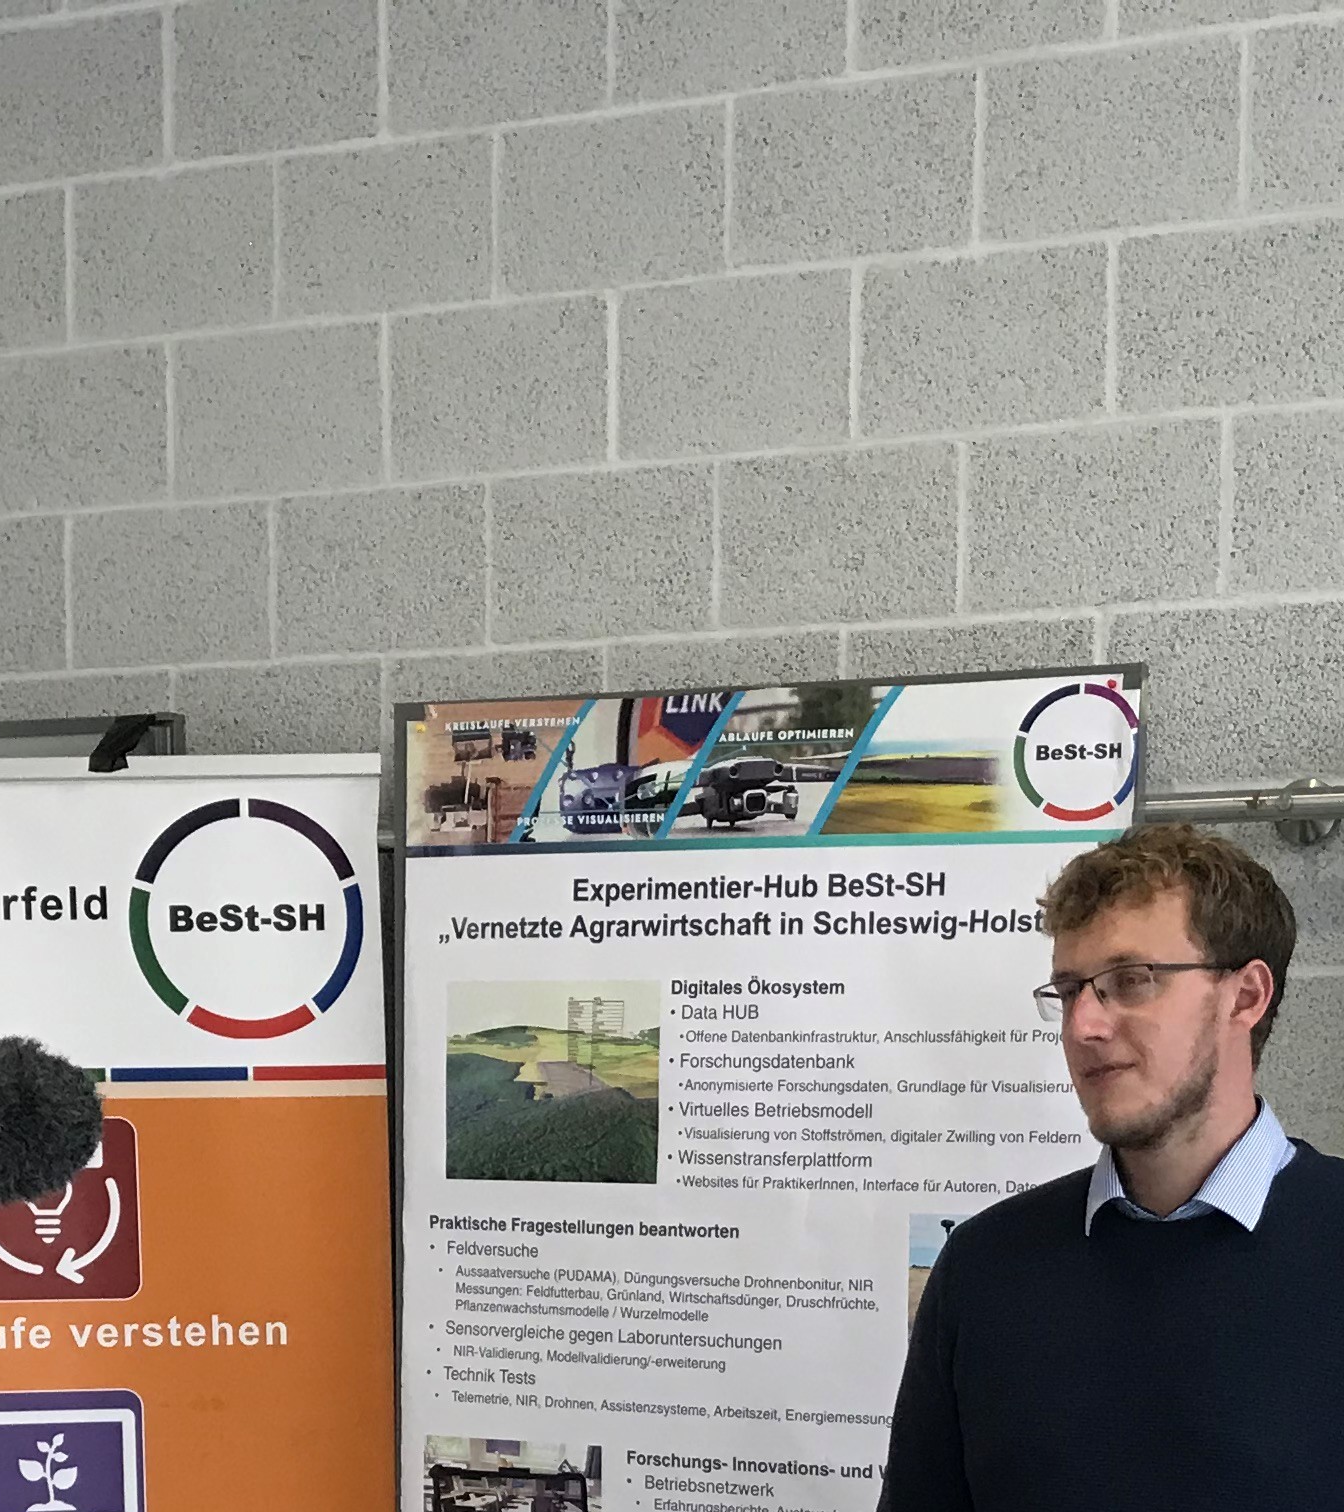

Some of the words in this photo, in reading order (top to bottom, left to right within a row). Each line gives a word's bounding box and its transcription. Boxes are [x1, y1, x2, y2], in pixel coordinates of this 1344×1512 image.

[1035, 742, 1123, 761] BeSt-SH
[573, 873, 819, 908] Experimentier-Hub
[827, 871, 946, 898] BeSt-SH
[168, 903, 326, 933] BeSt-SH
[569, 911, 772, 944] Agrarwirtschaft
[780, 911, 804, 936] in
[813, 908, 1043, 941] Schleswig-Holst
[671, 979, 743, 999] Digitales
[747, 975, 845, 999] Ökosystem
[681, 1004, 718, 1021] Data
[722, 1003, 760, 1020] HUB
[685, 1029, 728, 1043] Offene
[731, 1029, 880, 1045] Datenbankinfrastruktur,
[883, 1029, 1007, 1047] Anschlussfähigkeit
[679, 1052, 855, 1073] Forschungsdatenbank
[678, 1101, 750, 1118] Virtuelles
[754, 1102, 873, 1119] Betriebsmodell
[684, 1126, 770, 1144] Visualisierung
[800, 1127, 887, 1144] Stoffströmen,
[890, 1129, 943, 1146] digitaler
[945, 1129, 996, 1147] Zwilling
[1028, 1130, 1082, 1145] Feldern
[677, 1149, 873, 1171] Wissenstransferplattform
[682, 1174, 739, 1189] Websites
[862, 1178, 920, 1192] Interface
[943, 1179, 1001, 1195] Autoren,
[429, 1214, 507, 1232] Praktische
[511, 1217, 634, 1239] Fragestellungen
[638, 1221, 740, 1239] beantworten
[447, 1240, 539, 1259] Feldversuche
[68, 1314, 288, 1348] verstehen
[445, 1319, 565, 1343] Sensorvergleiche
[568, 1329, 614, 1346] gegen
[617, 1328, 783, 1354] Laboruntersuchungen
[443, 1365, 496, 1383] Technik
[499, 1368, 536, 1386] Tests
[451, 1389, 513, 1407] Telemetrie,
[544, 1395, 597, 1412] Drohnen,
[600, 1399, 711, 1419] Assistenzsysteme,
[713, 1405, 782, 1422] Arbeitszeit,
[626, 1449, 729, 1474] Forschungs-
[732, 1456, 836, 1477] Innovations-
[840, 1463, 873, 1479] und
[644, 1474, 775, 1498] Betriebsnetzwerk
